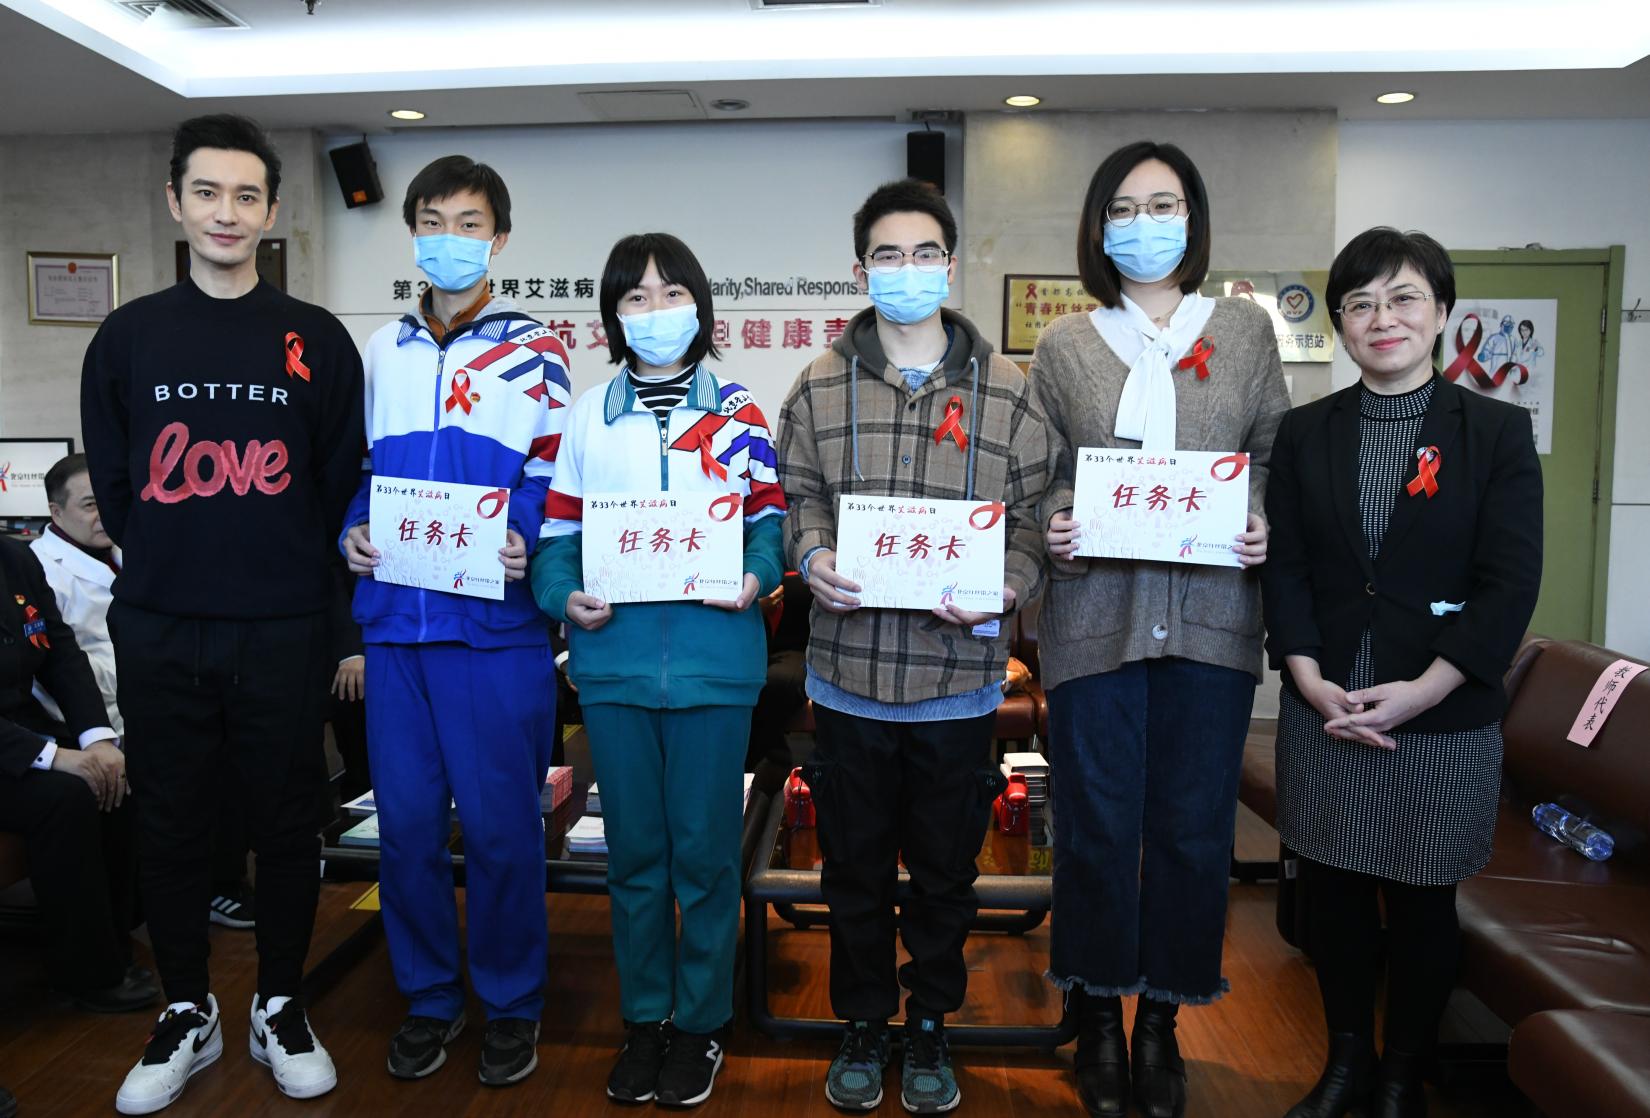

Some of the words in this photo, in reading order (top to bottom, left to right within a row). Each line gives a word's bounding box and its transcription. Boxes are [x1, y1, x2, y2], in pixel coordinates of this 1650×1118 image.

[797, 277, 869, 300] Respons
[154, 383, 289, 406] BOTTER
[140, 421, 292, 504] love
[1085, 454, 1177, 466] 第33个世界艾滋病日
[376, 484, 450, 500] 第33个世界艾滋病日
[591, 500, 677, 509] 第33个世界艾滋病日
[1112, 483, 1207, 513] 任务卡
[848, 502, 937, 515] 第33个世界艾滋病日
[399, 517, 473, 549] 任务卡
[619, 527, 707, 554] 任务卡
[874, 532, 966, 561] 任务卡
[1583, 665, 1633, 731] 教师代表
